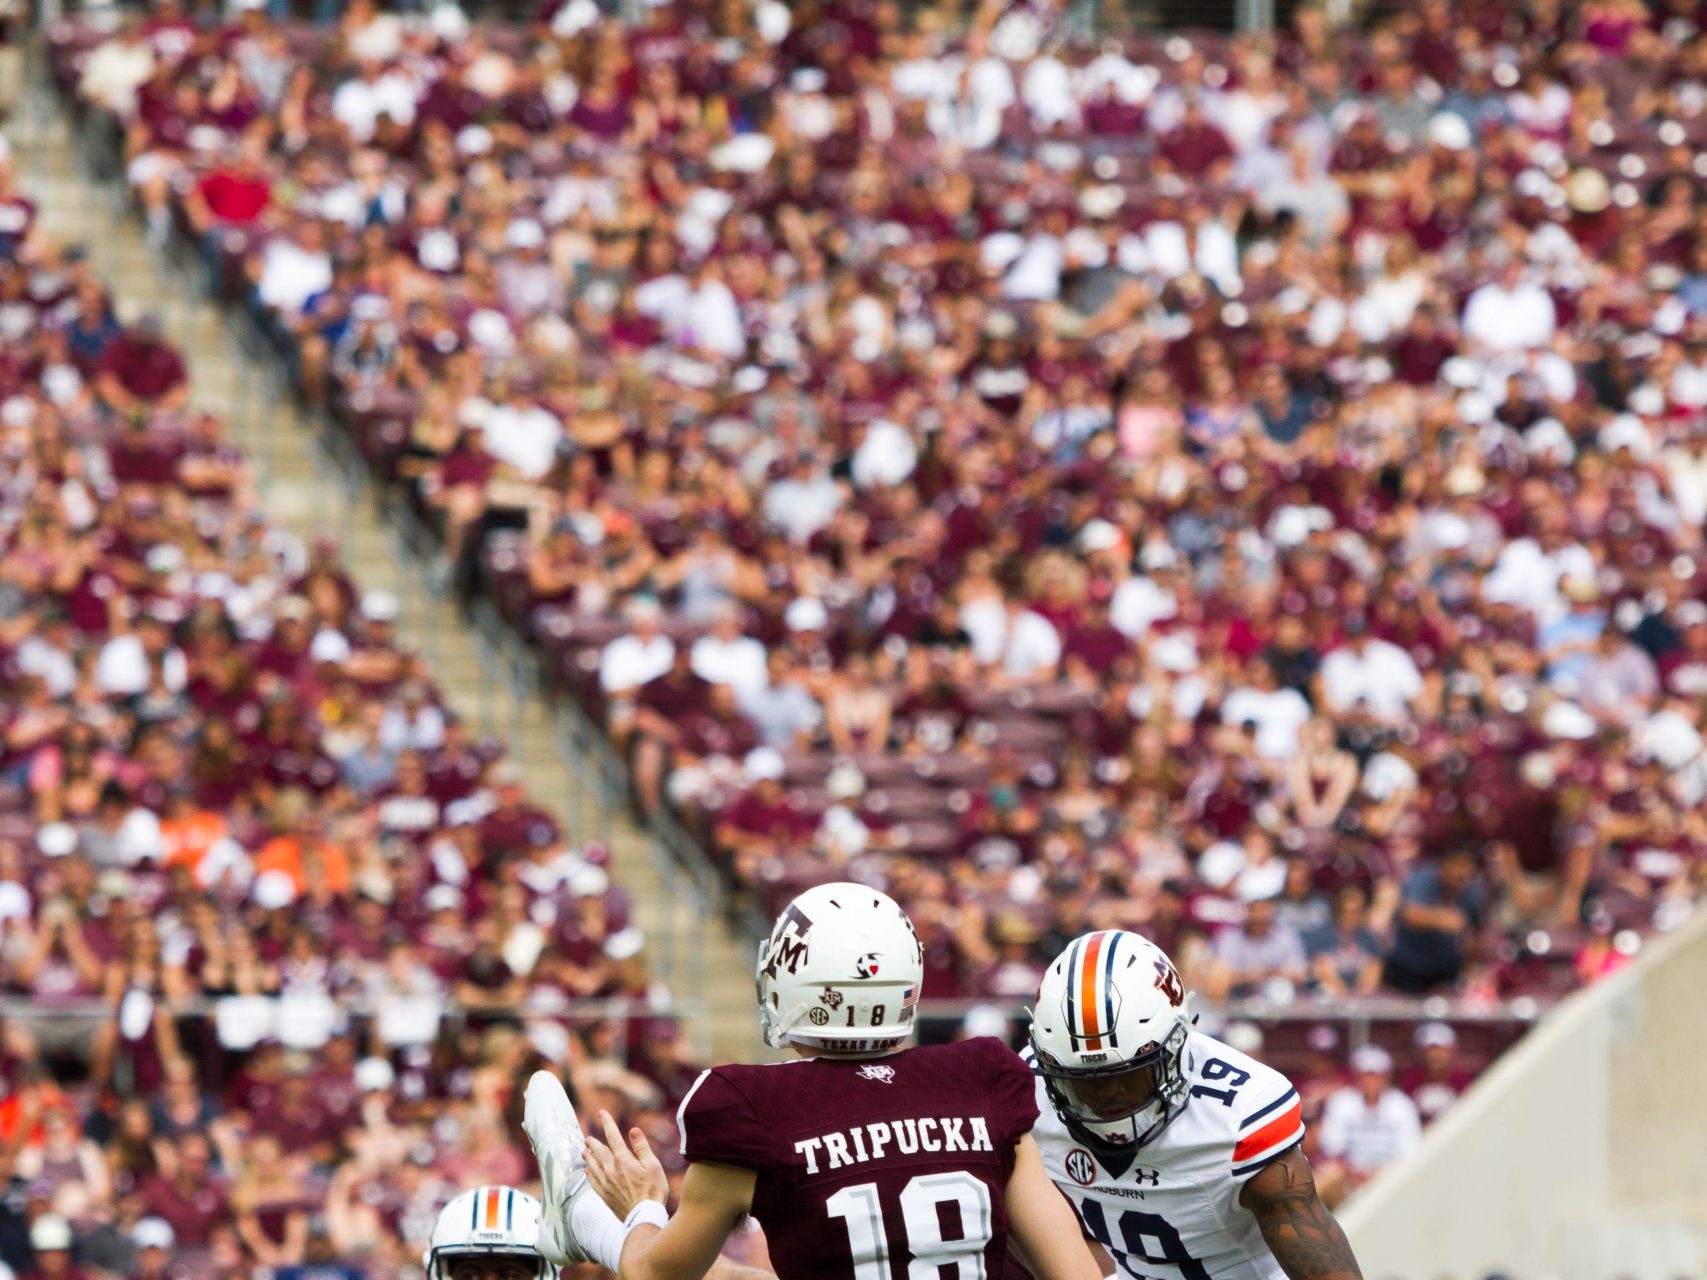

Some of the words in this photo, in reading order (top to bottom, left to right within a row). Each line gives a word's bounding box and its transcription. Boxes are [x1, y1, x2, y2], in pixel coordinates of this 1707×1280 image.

[1190, 1057, 1250, 1107] 19
[795, 1117, 994, 1175] TRIPUCKA
[1066, 1150, 1095, 1184] SEC
